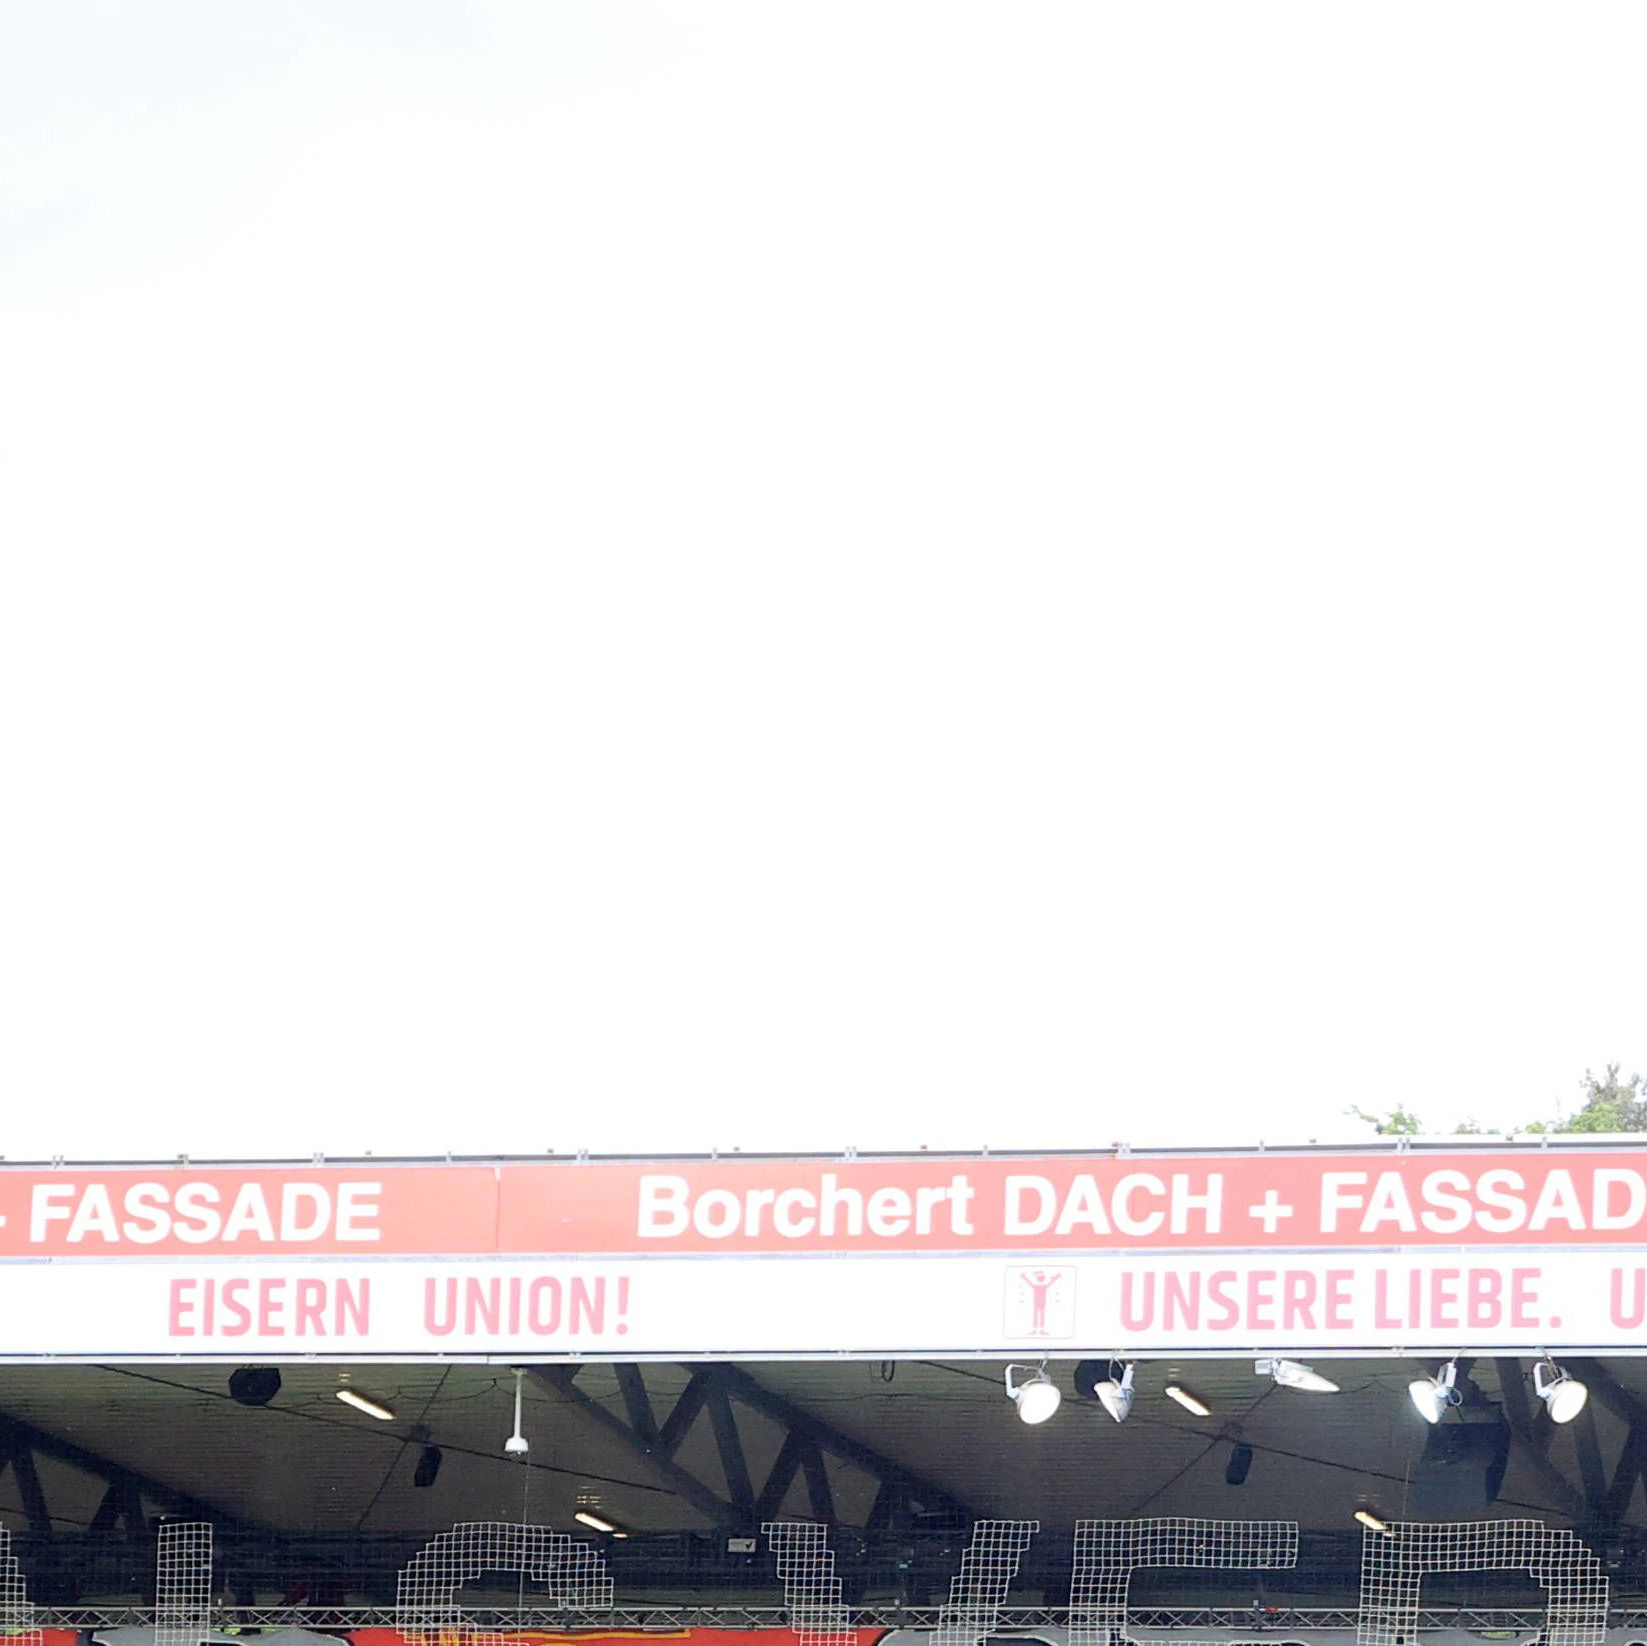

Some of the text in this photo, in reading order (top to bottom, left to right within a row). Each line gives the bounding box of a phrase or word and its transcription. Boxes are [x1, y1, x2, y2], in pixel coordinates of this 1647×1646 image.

[29, 1181, 382, 1243] FASSADE
[637, 1174, 973, 1238] Borchert
[1004, 1173, 1222, 1235] DACH
[1249, 1190, 1292, 1233] +
[168, 1276, 630, 1337] EISERN UNION!
[1120, 1269, 1354, 1332] UNSERE
[1374, 1267, 1561, 1330] LIEBE.
